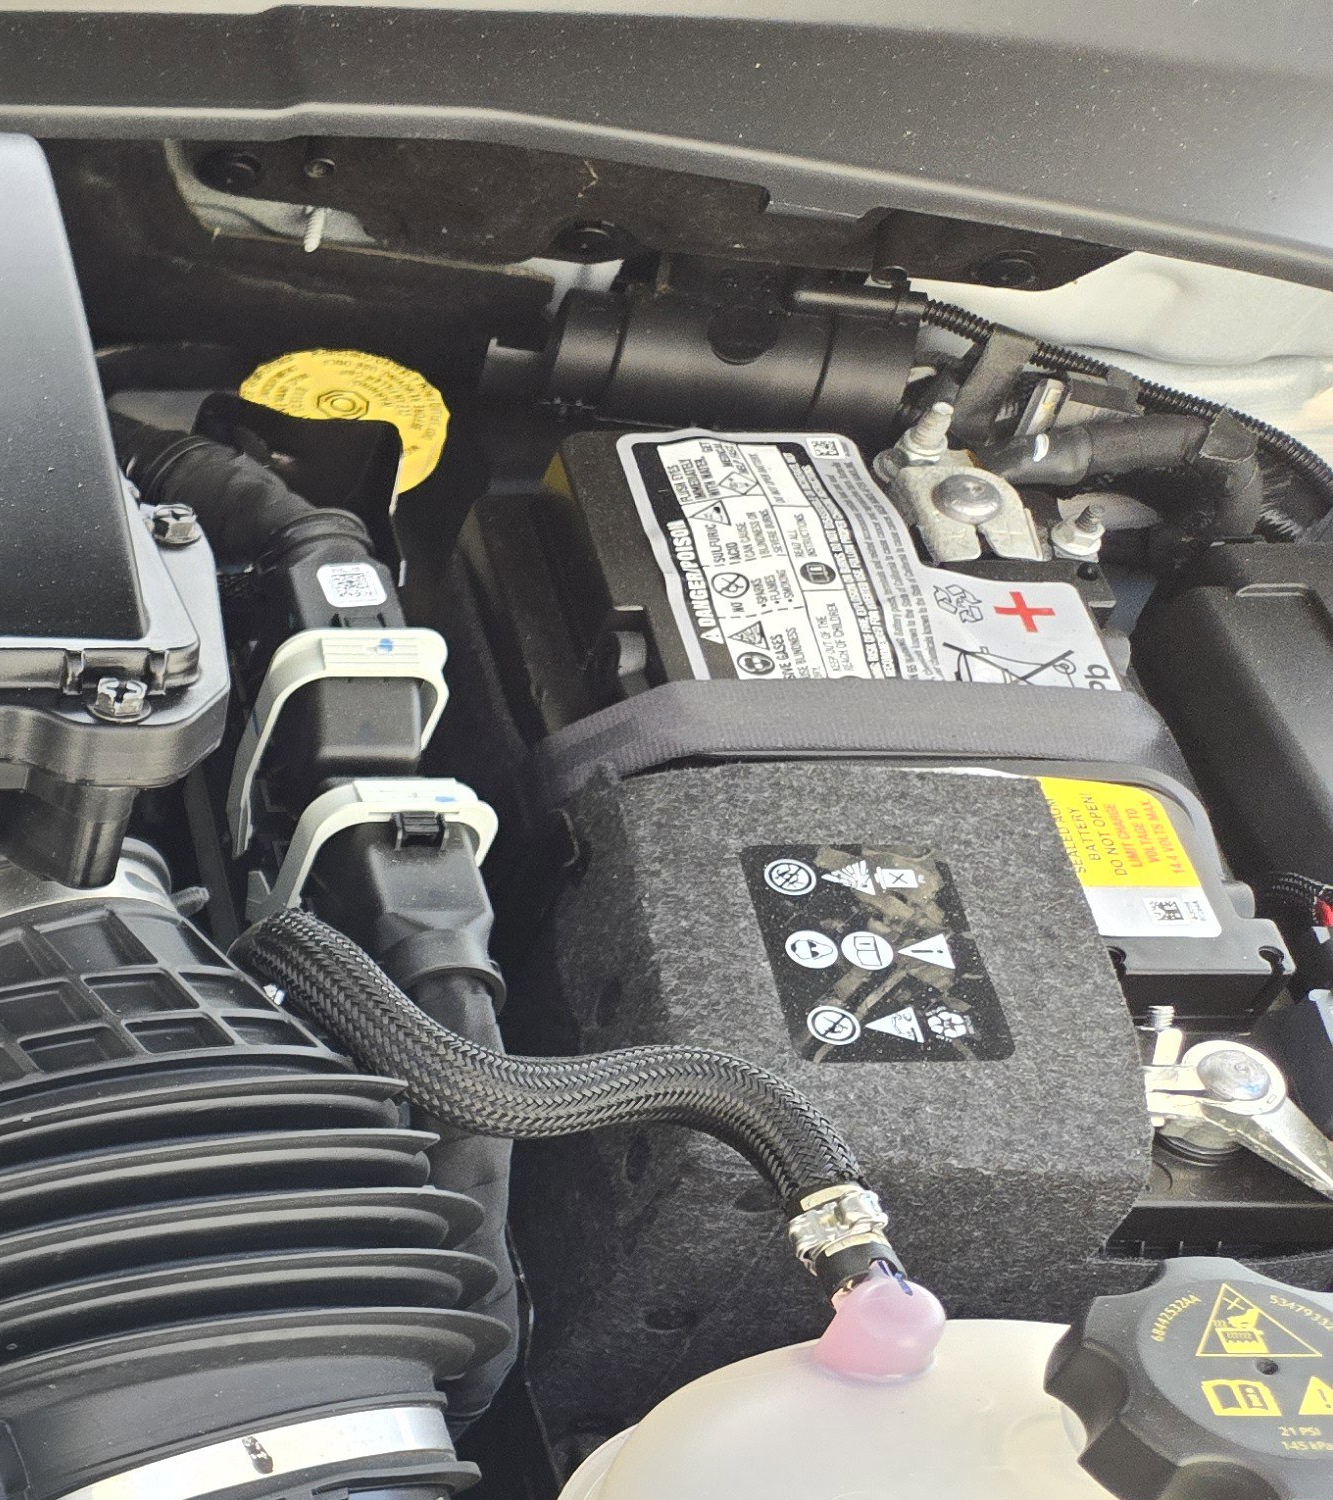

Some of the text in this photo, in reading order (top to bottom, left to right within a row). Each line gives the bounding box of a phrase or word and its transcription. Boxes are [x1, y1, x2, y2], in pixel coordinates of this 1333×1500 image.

[704, 522, 726, 564] SULFURIC
[726, 542, 743, 562] ACID
[1060, 823, 1087, 873] SEALED
[1068, 806, 1102, 861] BATTERY
[1097, 832, 1119, 857] NOT
[1102, 803, 1144, 868] LIMIT CHARGE
[1125, 808, 1160, 864] VOLTAGE TO
[1151, 823, 1174, 853] VOLTS
[1111, 859, 1128, 876] DO
[1278, 1426, 1322, 1437] 21 PSI
